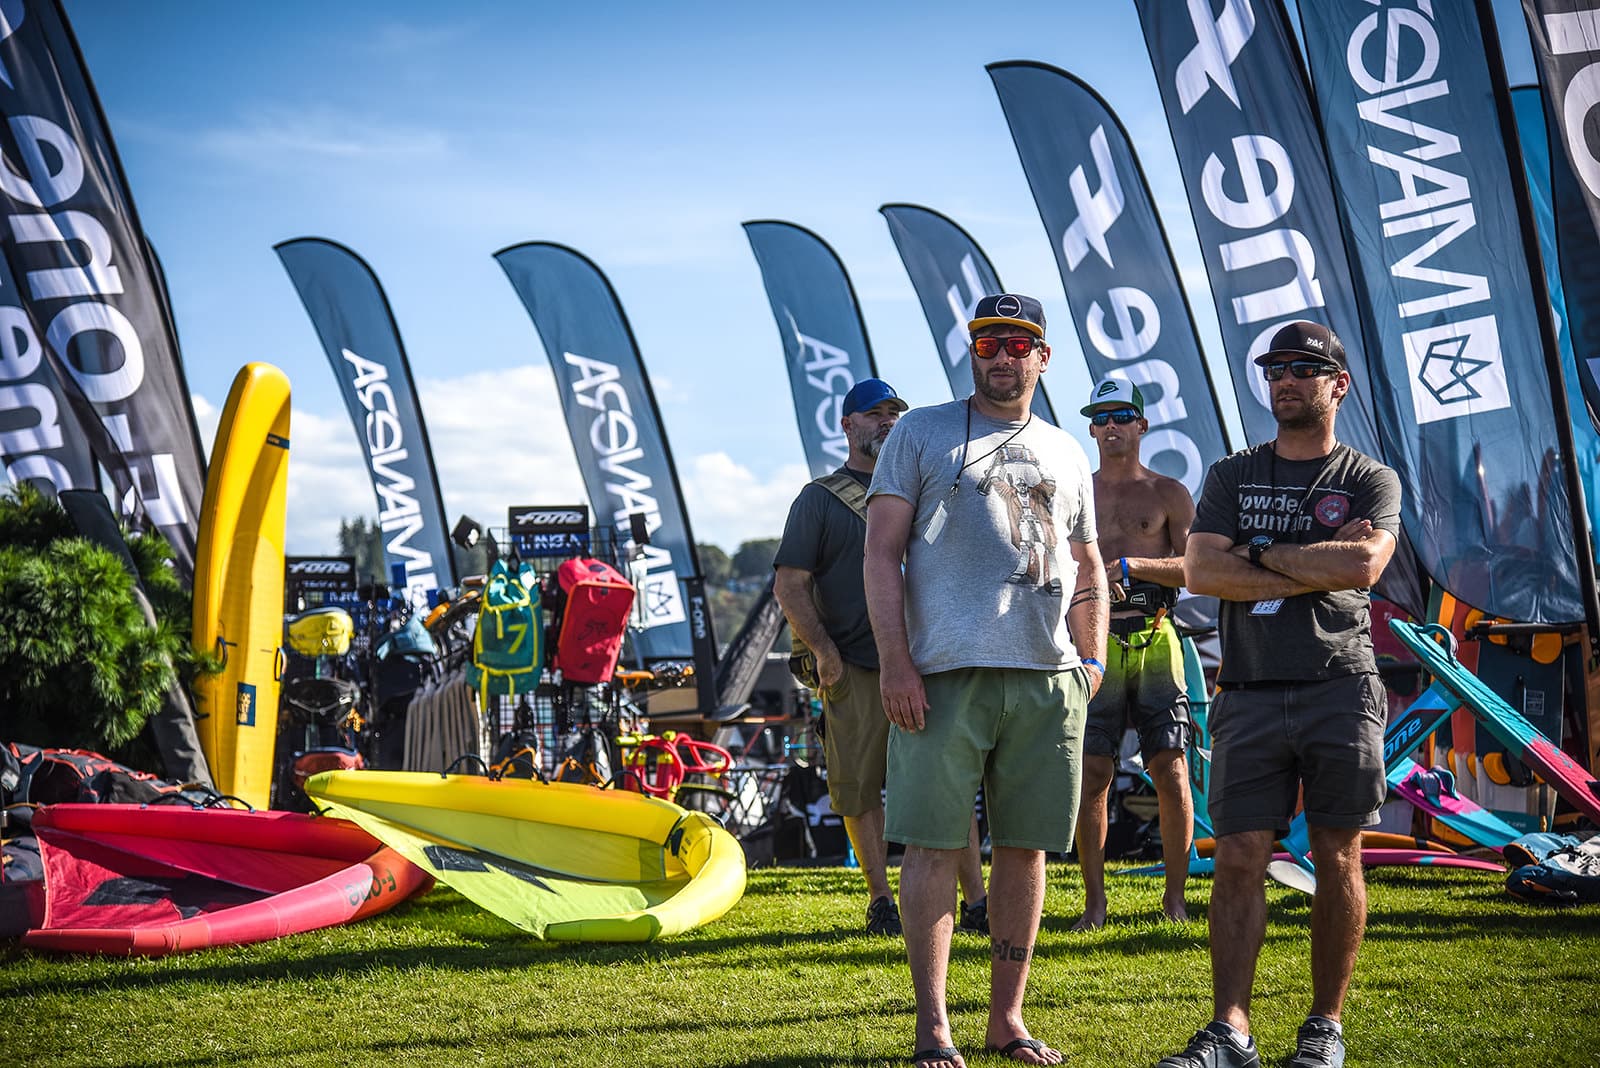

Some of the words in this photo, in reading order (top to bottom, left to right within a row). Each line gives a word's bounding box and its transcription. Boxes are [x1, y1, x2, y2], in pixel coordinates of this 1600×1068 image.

[1239, 493, 1300, 513] owde
[1239, 510, 1313, 532] ountin
[1383, 717, 1422, 762] one
